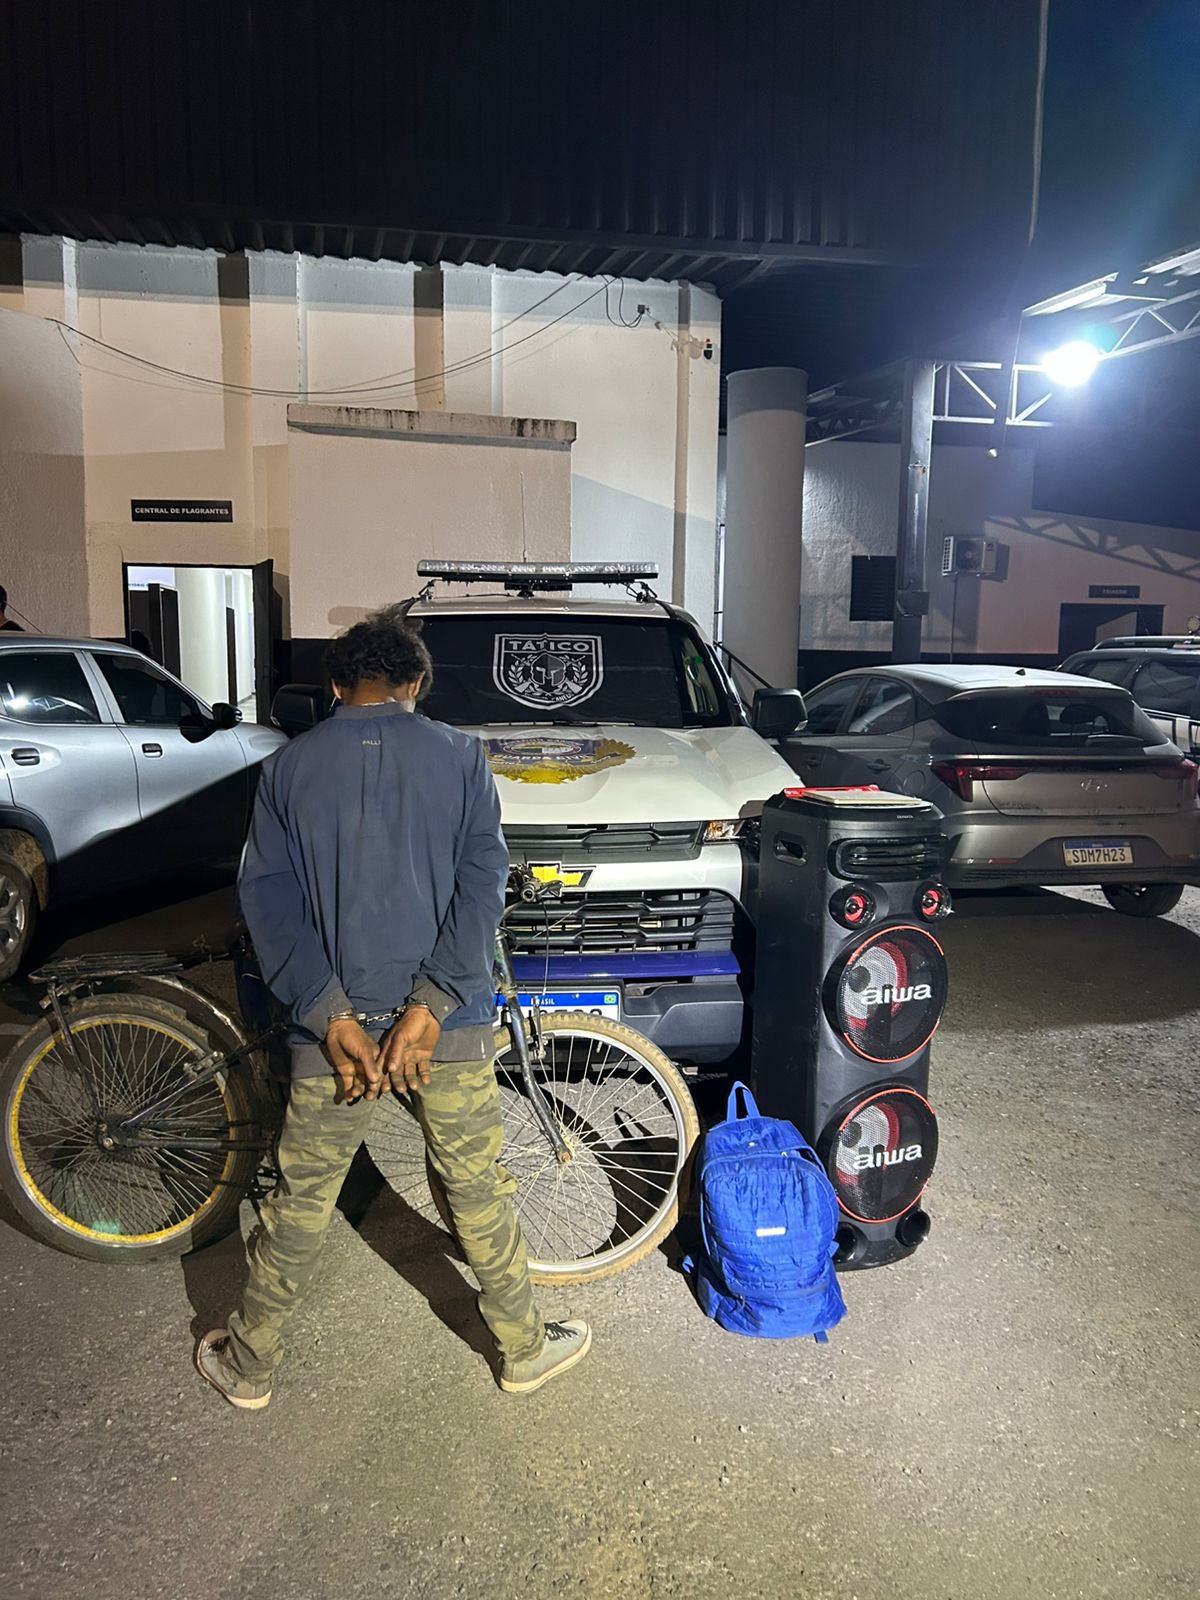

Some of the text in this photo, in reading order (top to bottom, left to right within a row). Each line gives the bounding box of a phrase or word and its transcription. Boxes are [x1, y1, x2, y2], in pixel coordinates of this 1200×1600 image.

[182, 507, 229, 515] FLAGRANTES
[1072, 848, 1126, 864] SDM7H23
[861, 984, 932, 1005] aiwa
[852, 1144, 923, 1170] aiwa
